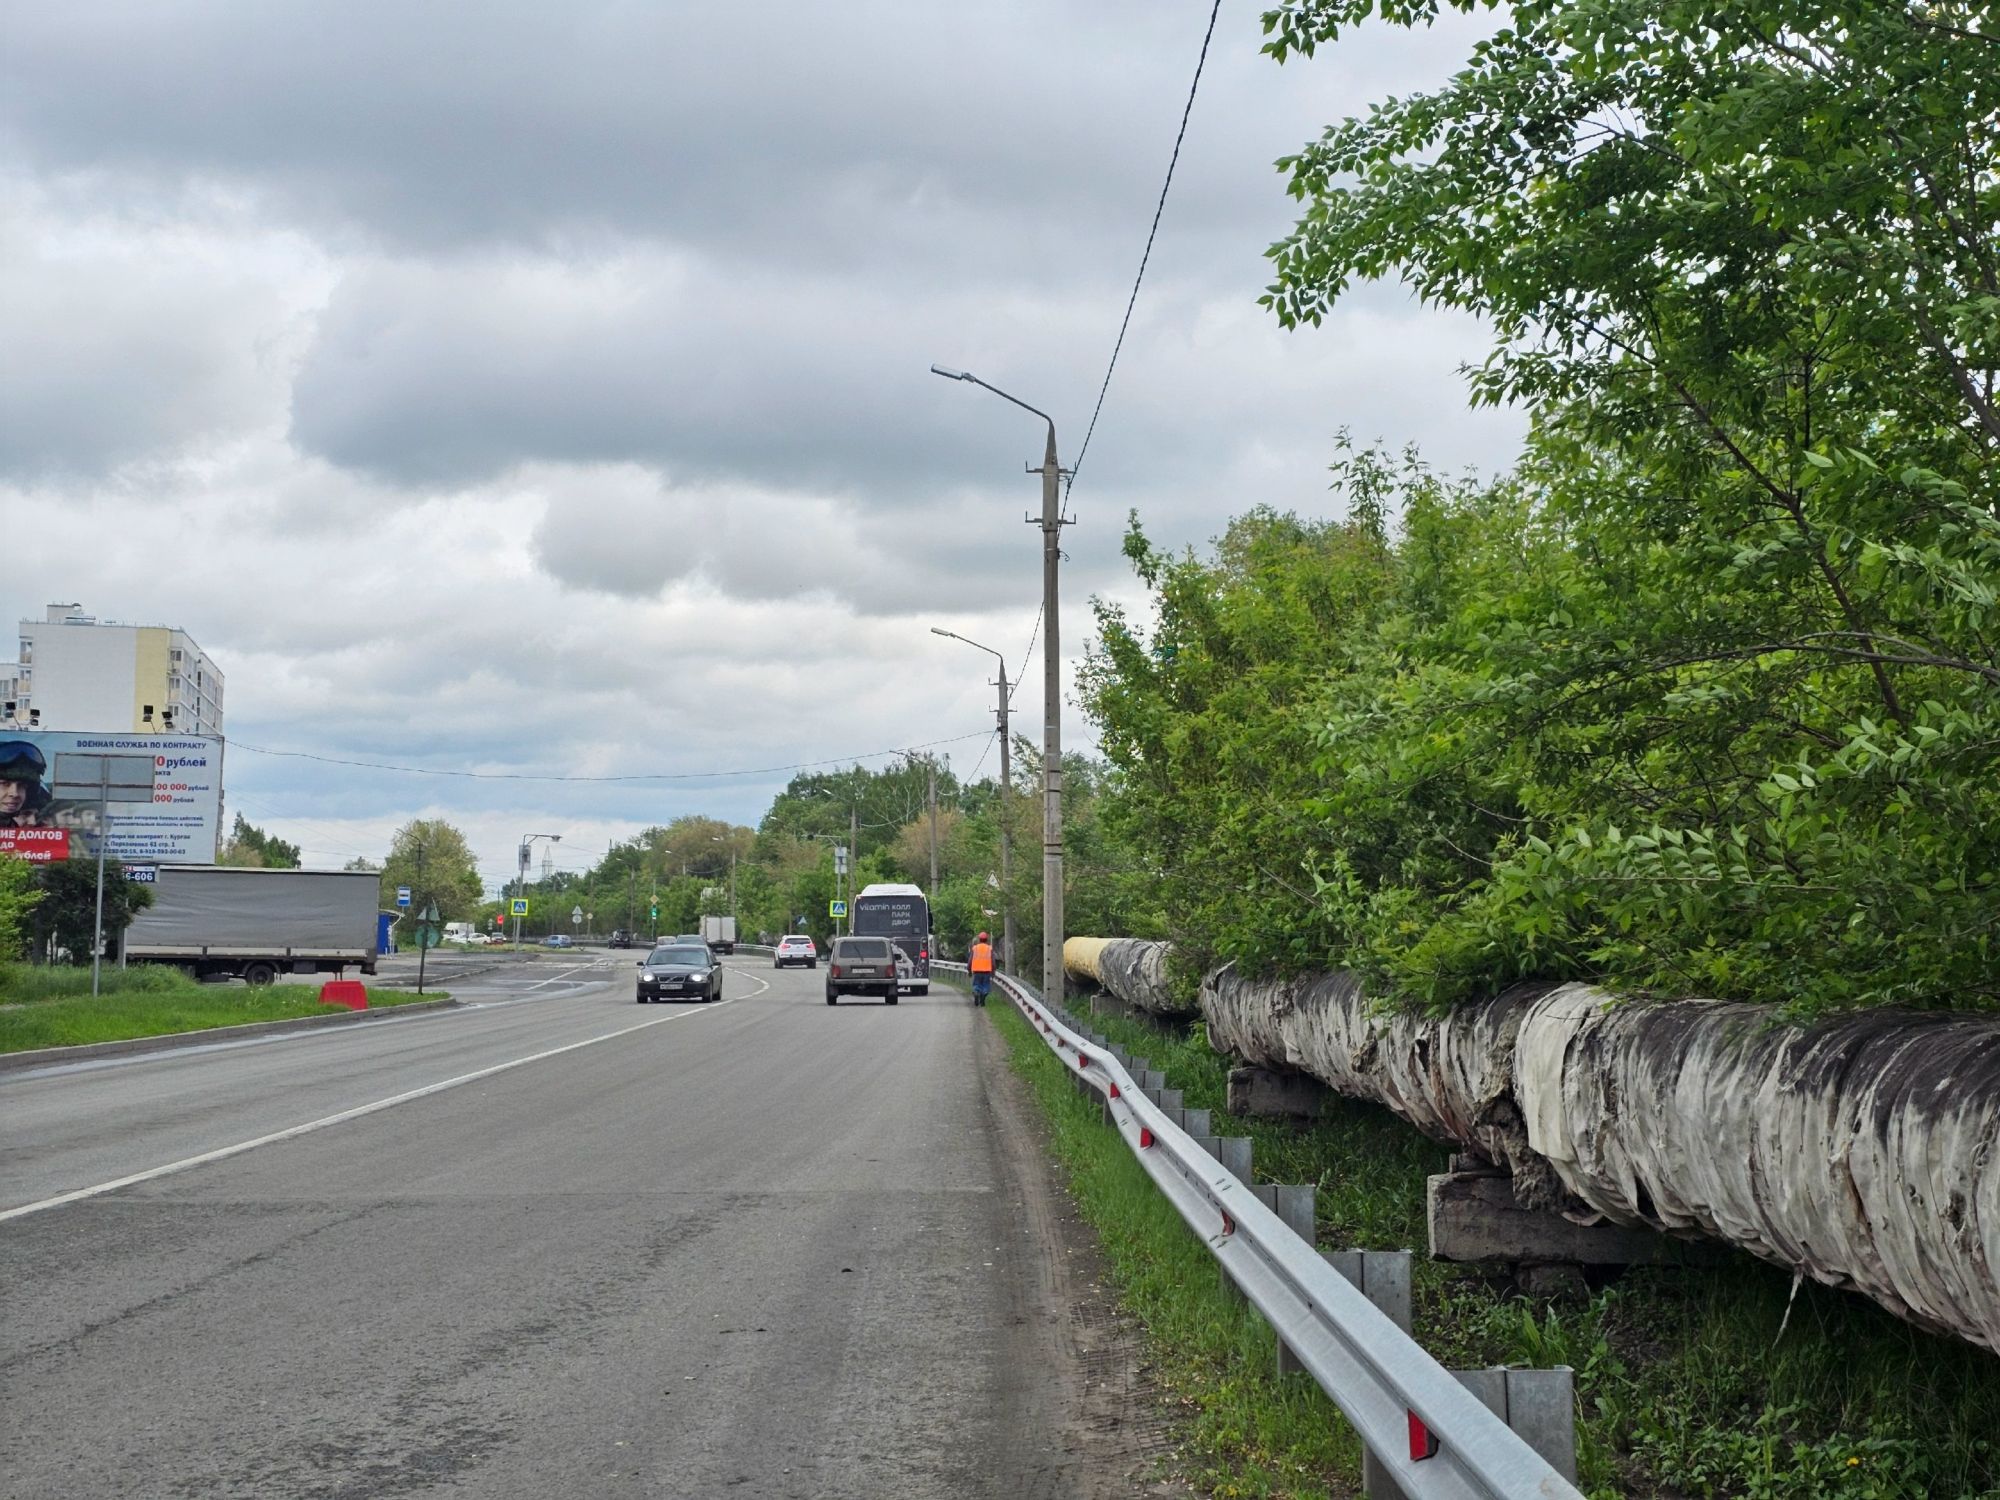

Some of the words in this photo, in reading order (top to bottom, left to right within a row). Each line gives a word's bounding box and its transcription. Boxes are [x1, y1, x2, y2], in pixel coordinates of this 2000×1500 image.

[76, 740, 114, 748] ВОЕННАЯ
[115, 740, 148, 748] СЛУЖБА
[150, 741, 161, 749] ПО
[163, 741, 207, 749] КОНТРАКТУ
[166, 757, 207, 768] рублей
[17, 830, 63, 840] ДОЛГОВ
